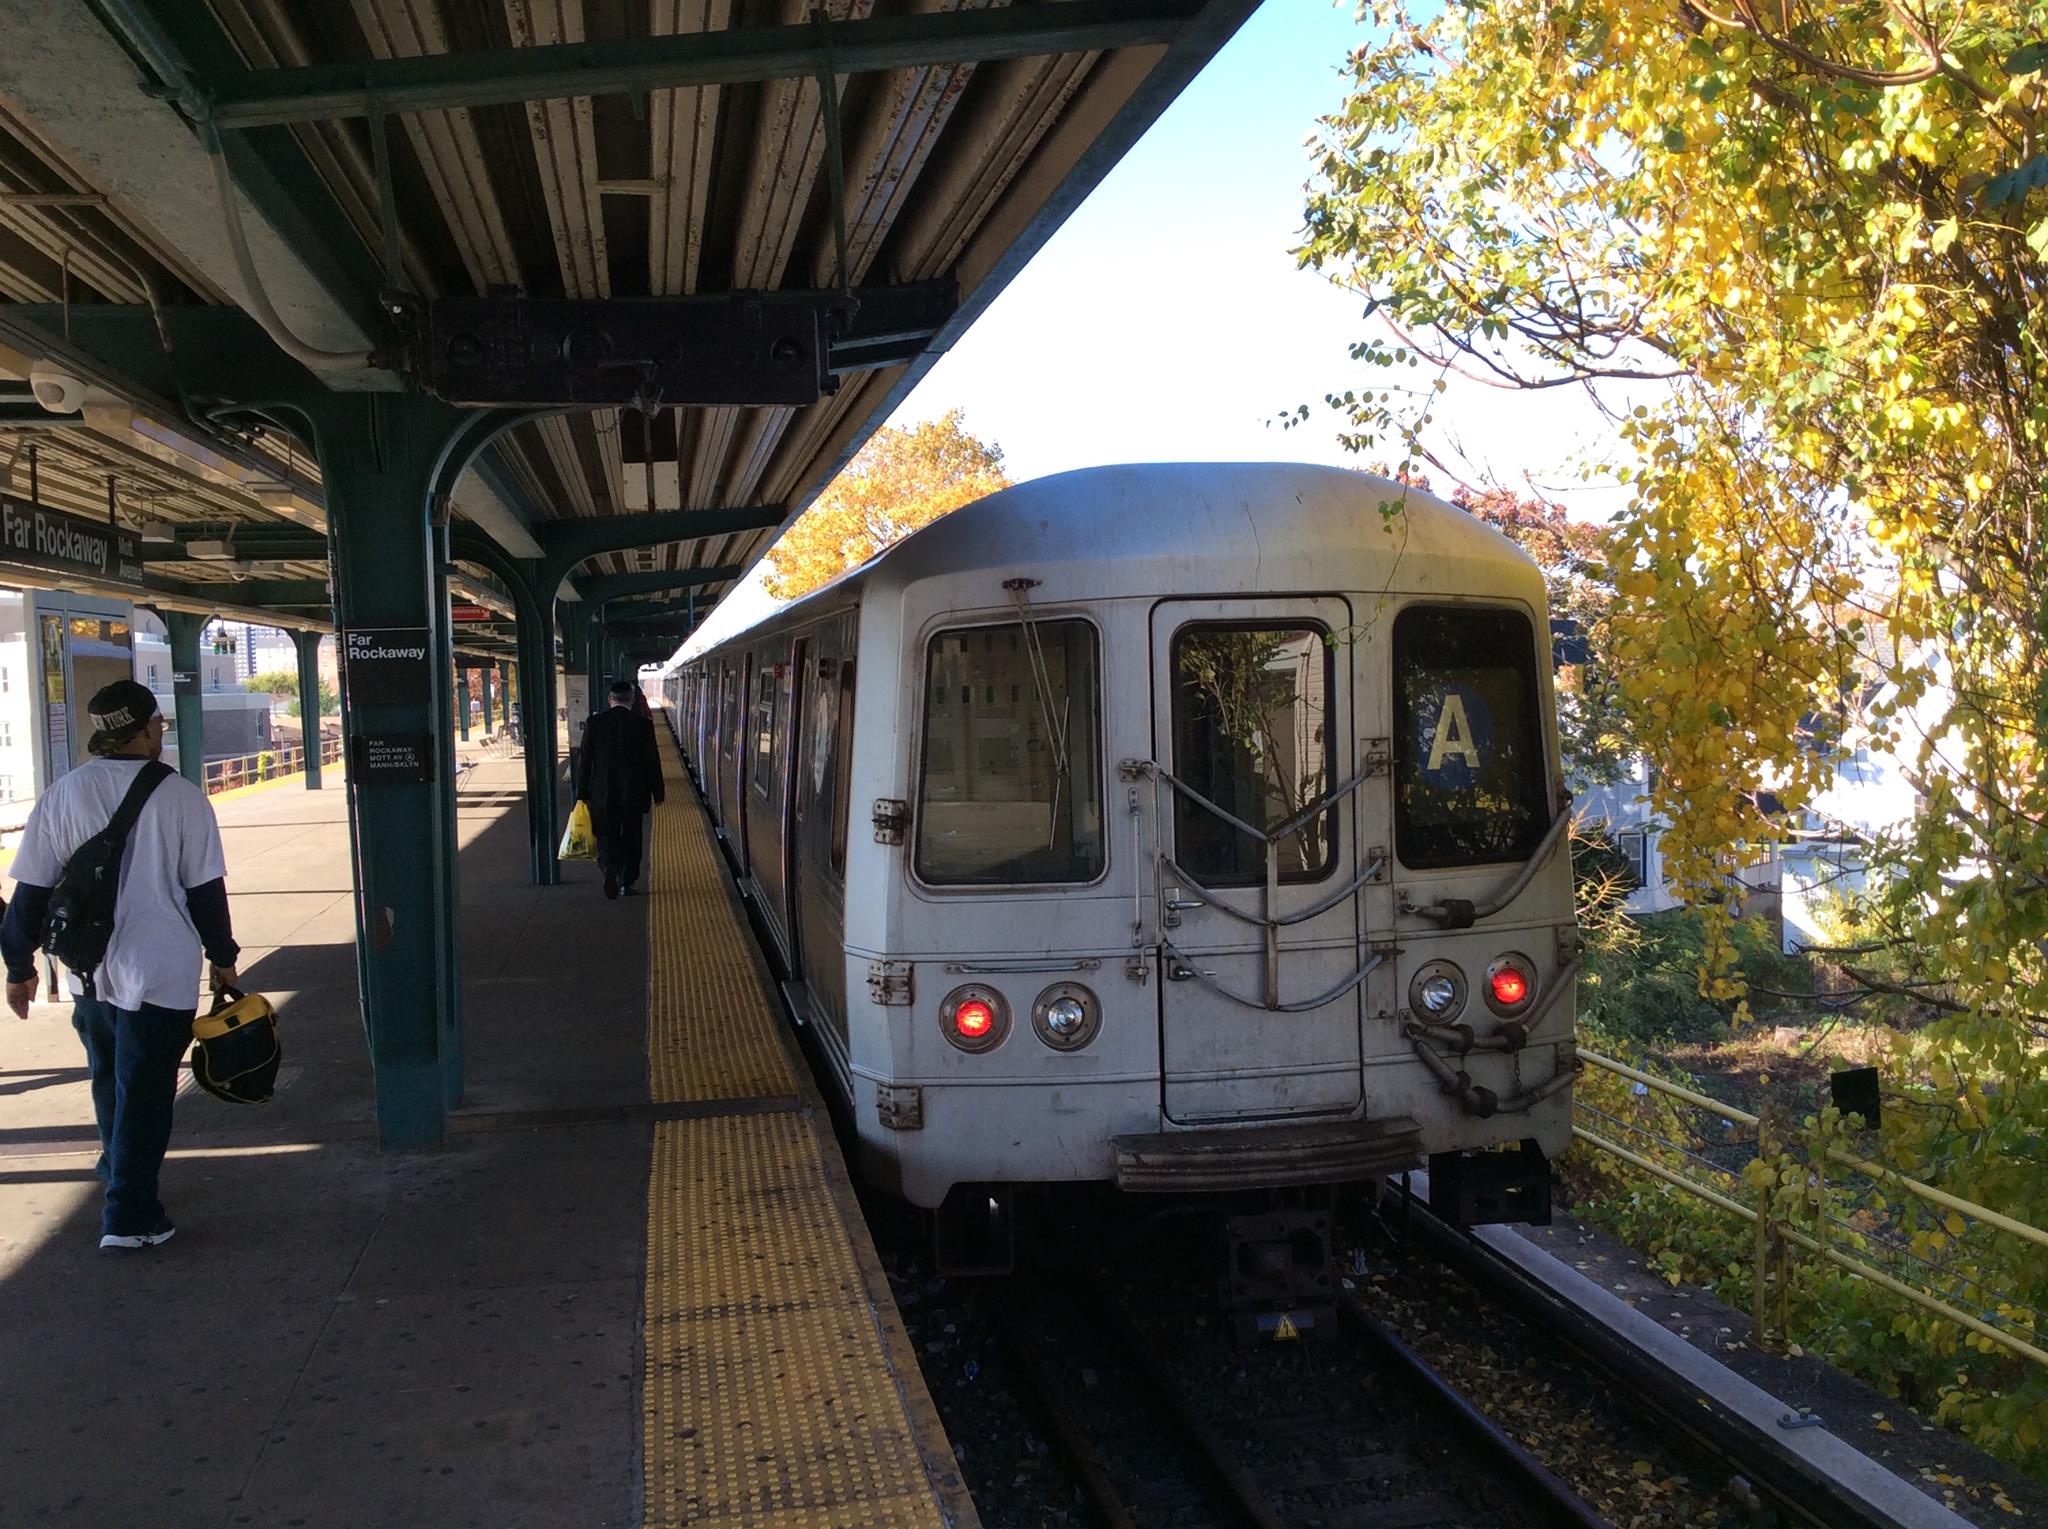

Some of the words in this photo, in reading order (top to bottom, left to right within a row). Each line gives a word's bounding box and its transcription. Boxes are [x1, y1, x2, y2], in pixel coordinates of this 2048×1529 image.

[3, 503, 31, 549] Far
[35, 513, 108, 575] Rockaway
[118, 536, 135, 557] Mott
[119, 559, 143, 582] Avenue
[348, 634, 373, 646] Far
[349, 647, 426, 660] Rockaway
[102, 706, 135, 733] YORK
[1427, 694, 1480, 770] A
